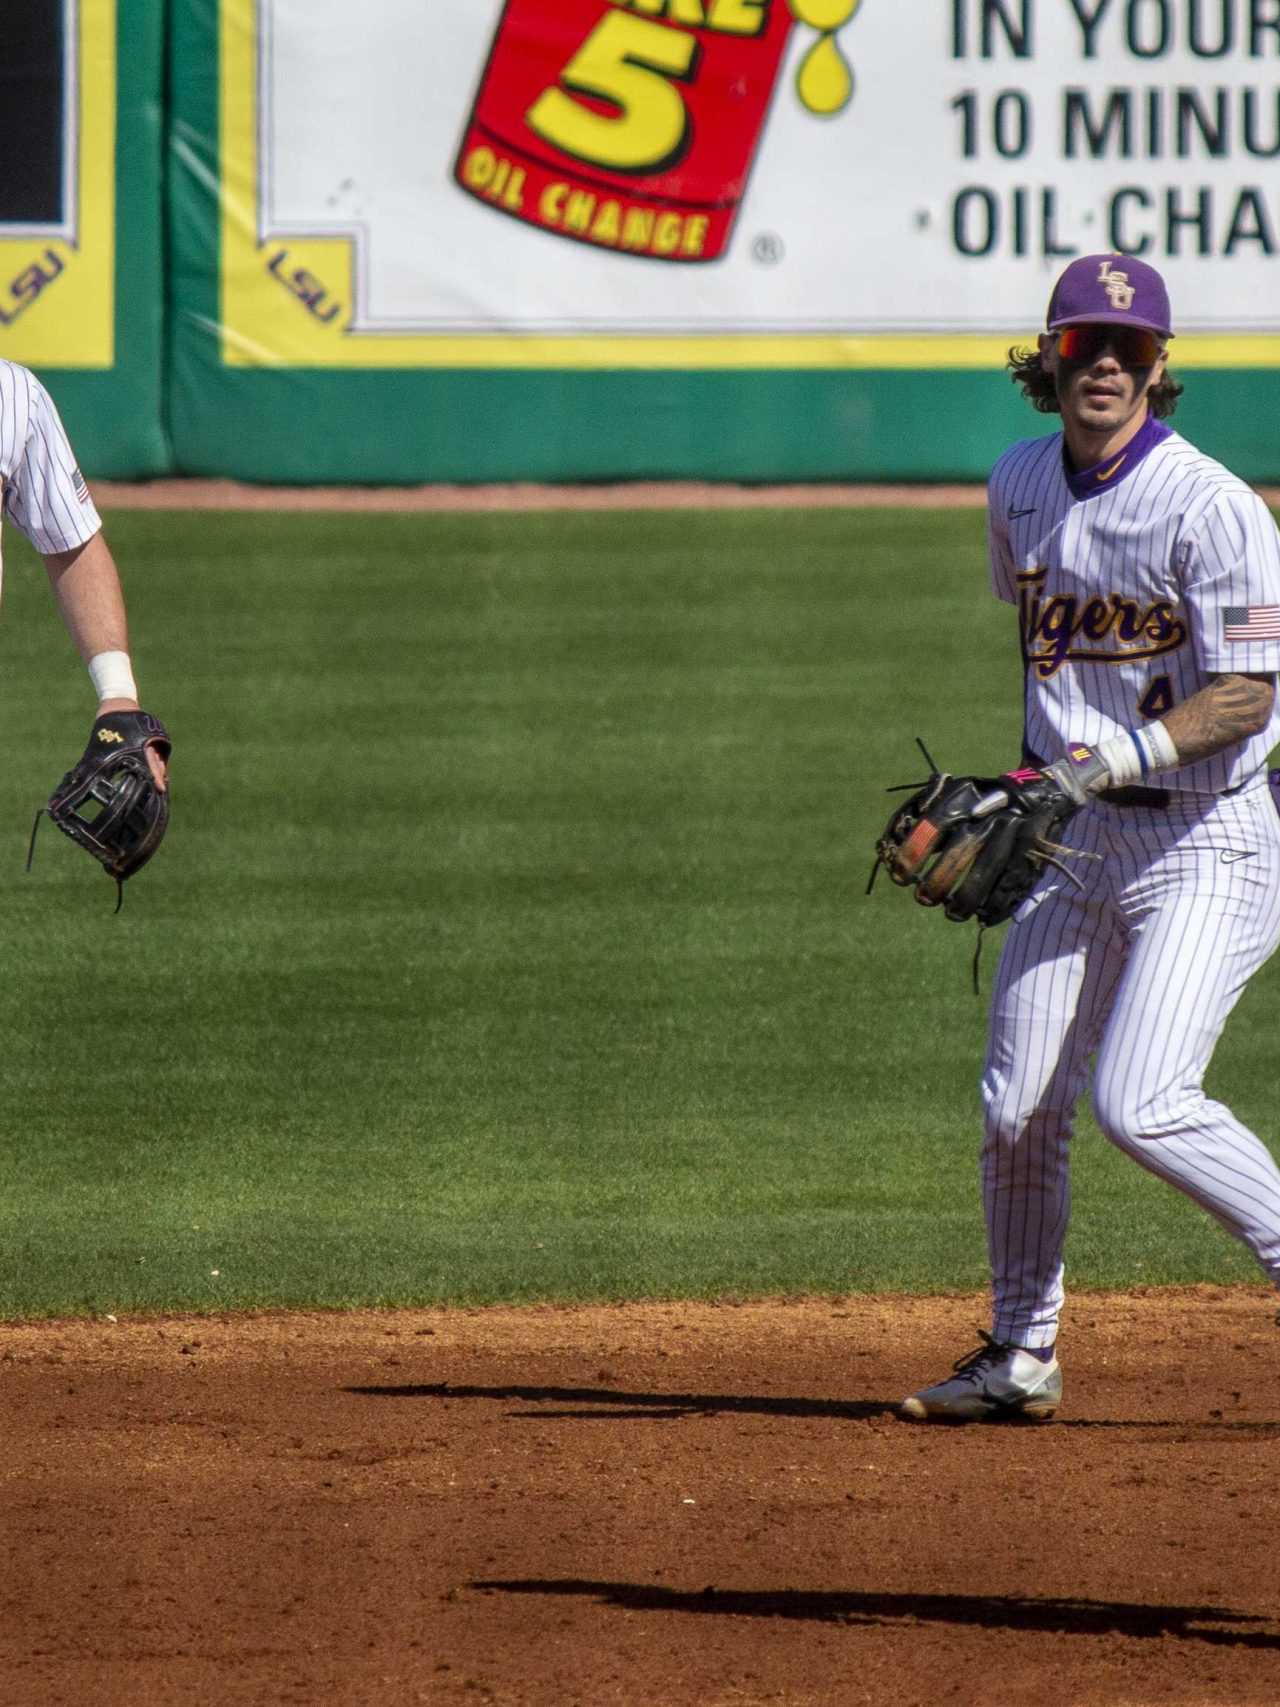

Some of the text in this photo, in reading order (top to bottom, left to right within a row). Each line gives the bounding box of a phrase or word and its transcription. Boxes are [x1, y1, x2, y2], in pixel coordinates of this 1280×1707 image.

[950, 0, 1034, 59] IN
[525, 8, 700, 175] 5
[950, 86, 1032, 159] 10
[463, 146, 710, 256] OIL CHANGE
[951, 186, 1076, 258] OIL
[266, 248, 342, 324] LSU
[1097, 261, 1135, 310] LSU
[1138, 675, 1175, 719] 4
